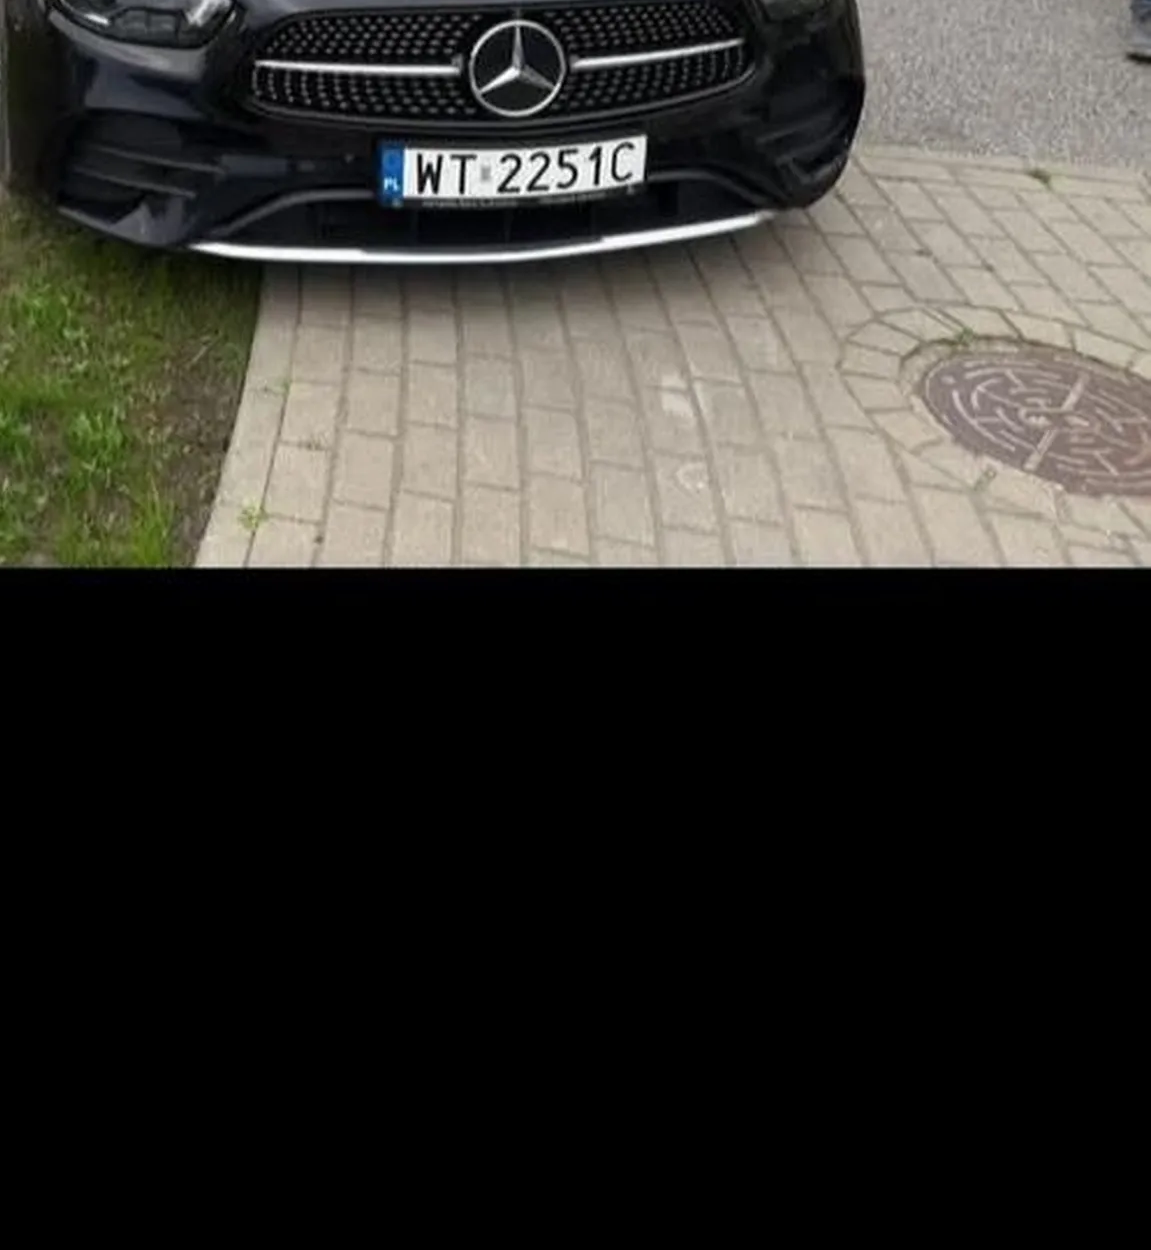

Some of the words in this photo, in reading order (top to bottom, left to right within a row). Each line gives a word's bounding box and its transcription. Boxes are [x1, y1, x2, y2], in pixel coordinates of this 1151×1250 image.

[383, 177, 400, 192] PL
[416, 153, 478, 195] WT
[497, 141, 636, 195] 2251C
